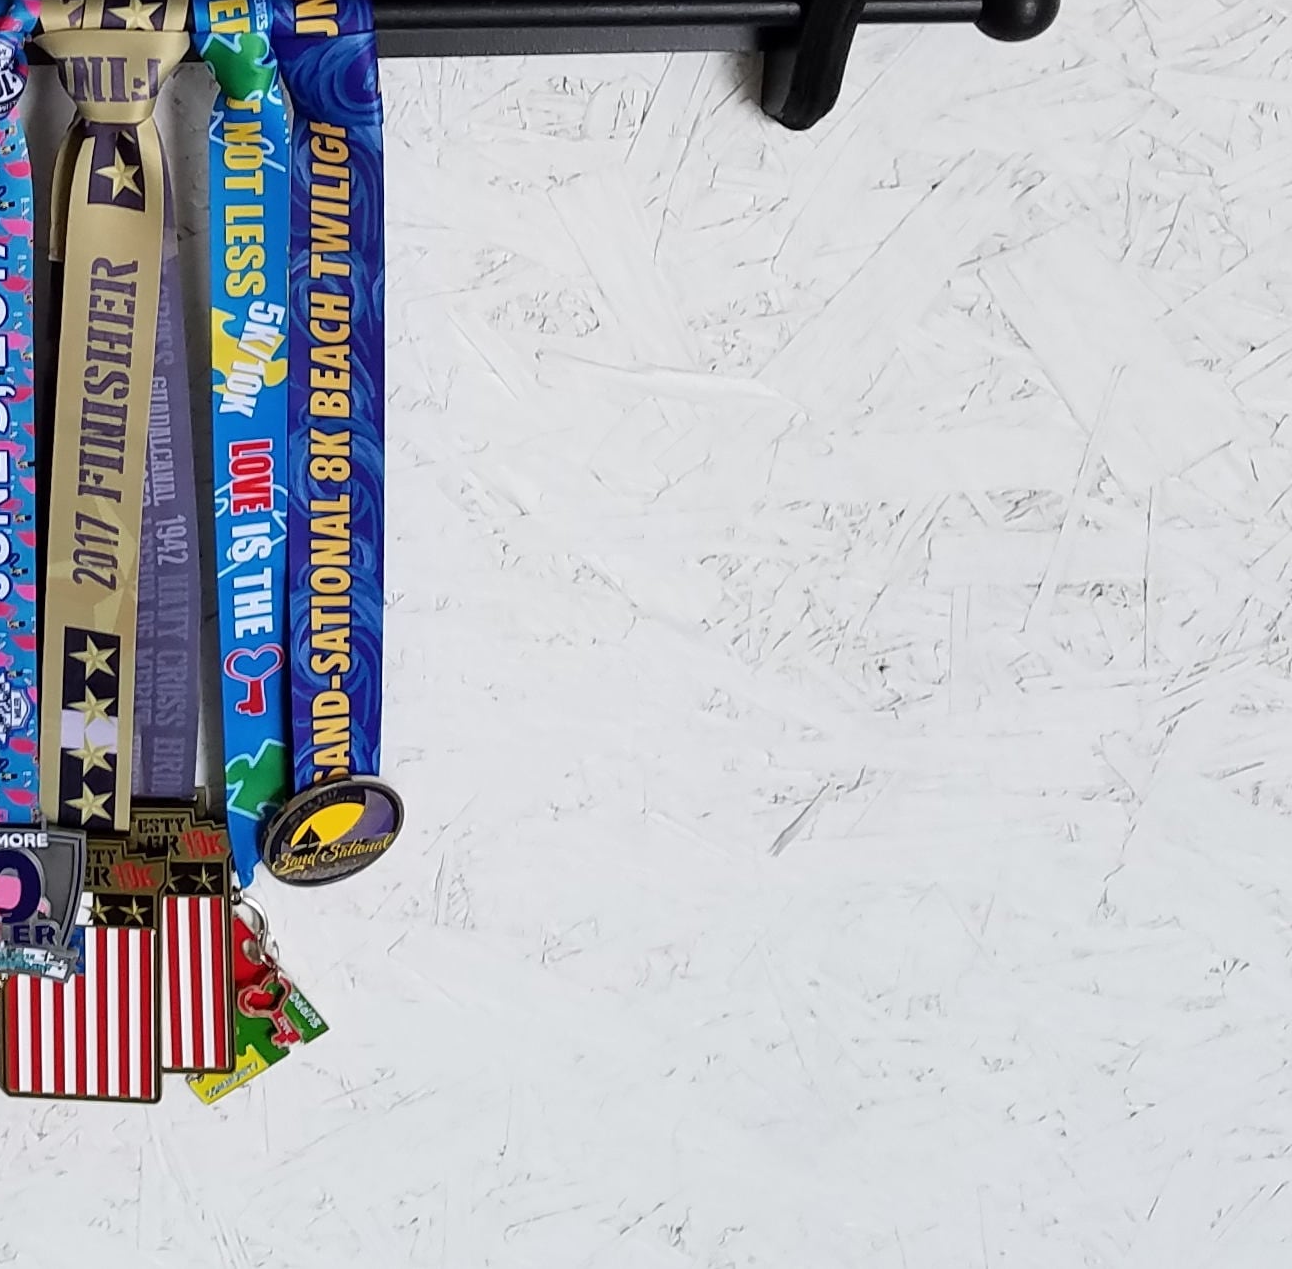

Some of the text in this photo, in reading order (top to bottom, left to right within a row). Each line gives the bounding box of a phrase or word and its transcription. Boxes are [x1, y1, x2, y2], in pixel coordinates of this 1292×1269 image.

[223, 120, 267, 298] NOT LESS
[219, 301, 286, 419] 5K/10K
[310, 291, 351, 419] BEACH
[72, 256, 139, 590] 2017 FINISHER
[310, 429, 352, 483] 8K
[155, 514, 189, 567] 1942
[228, 438, 274, 640] LOVE IS THE
[156, 572, 189, 641] NAVY
[154, 649, 189, 728] CROSS
